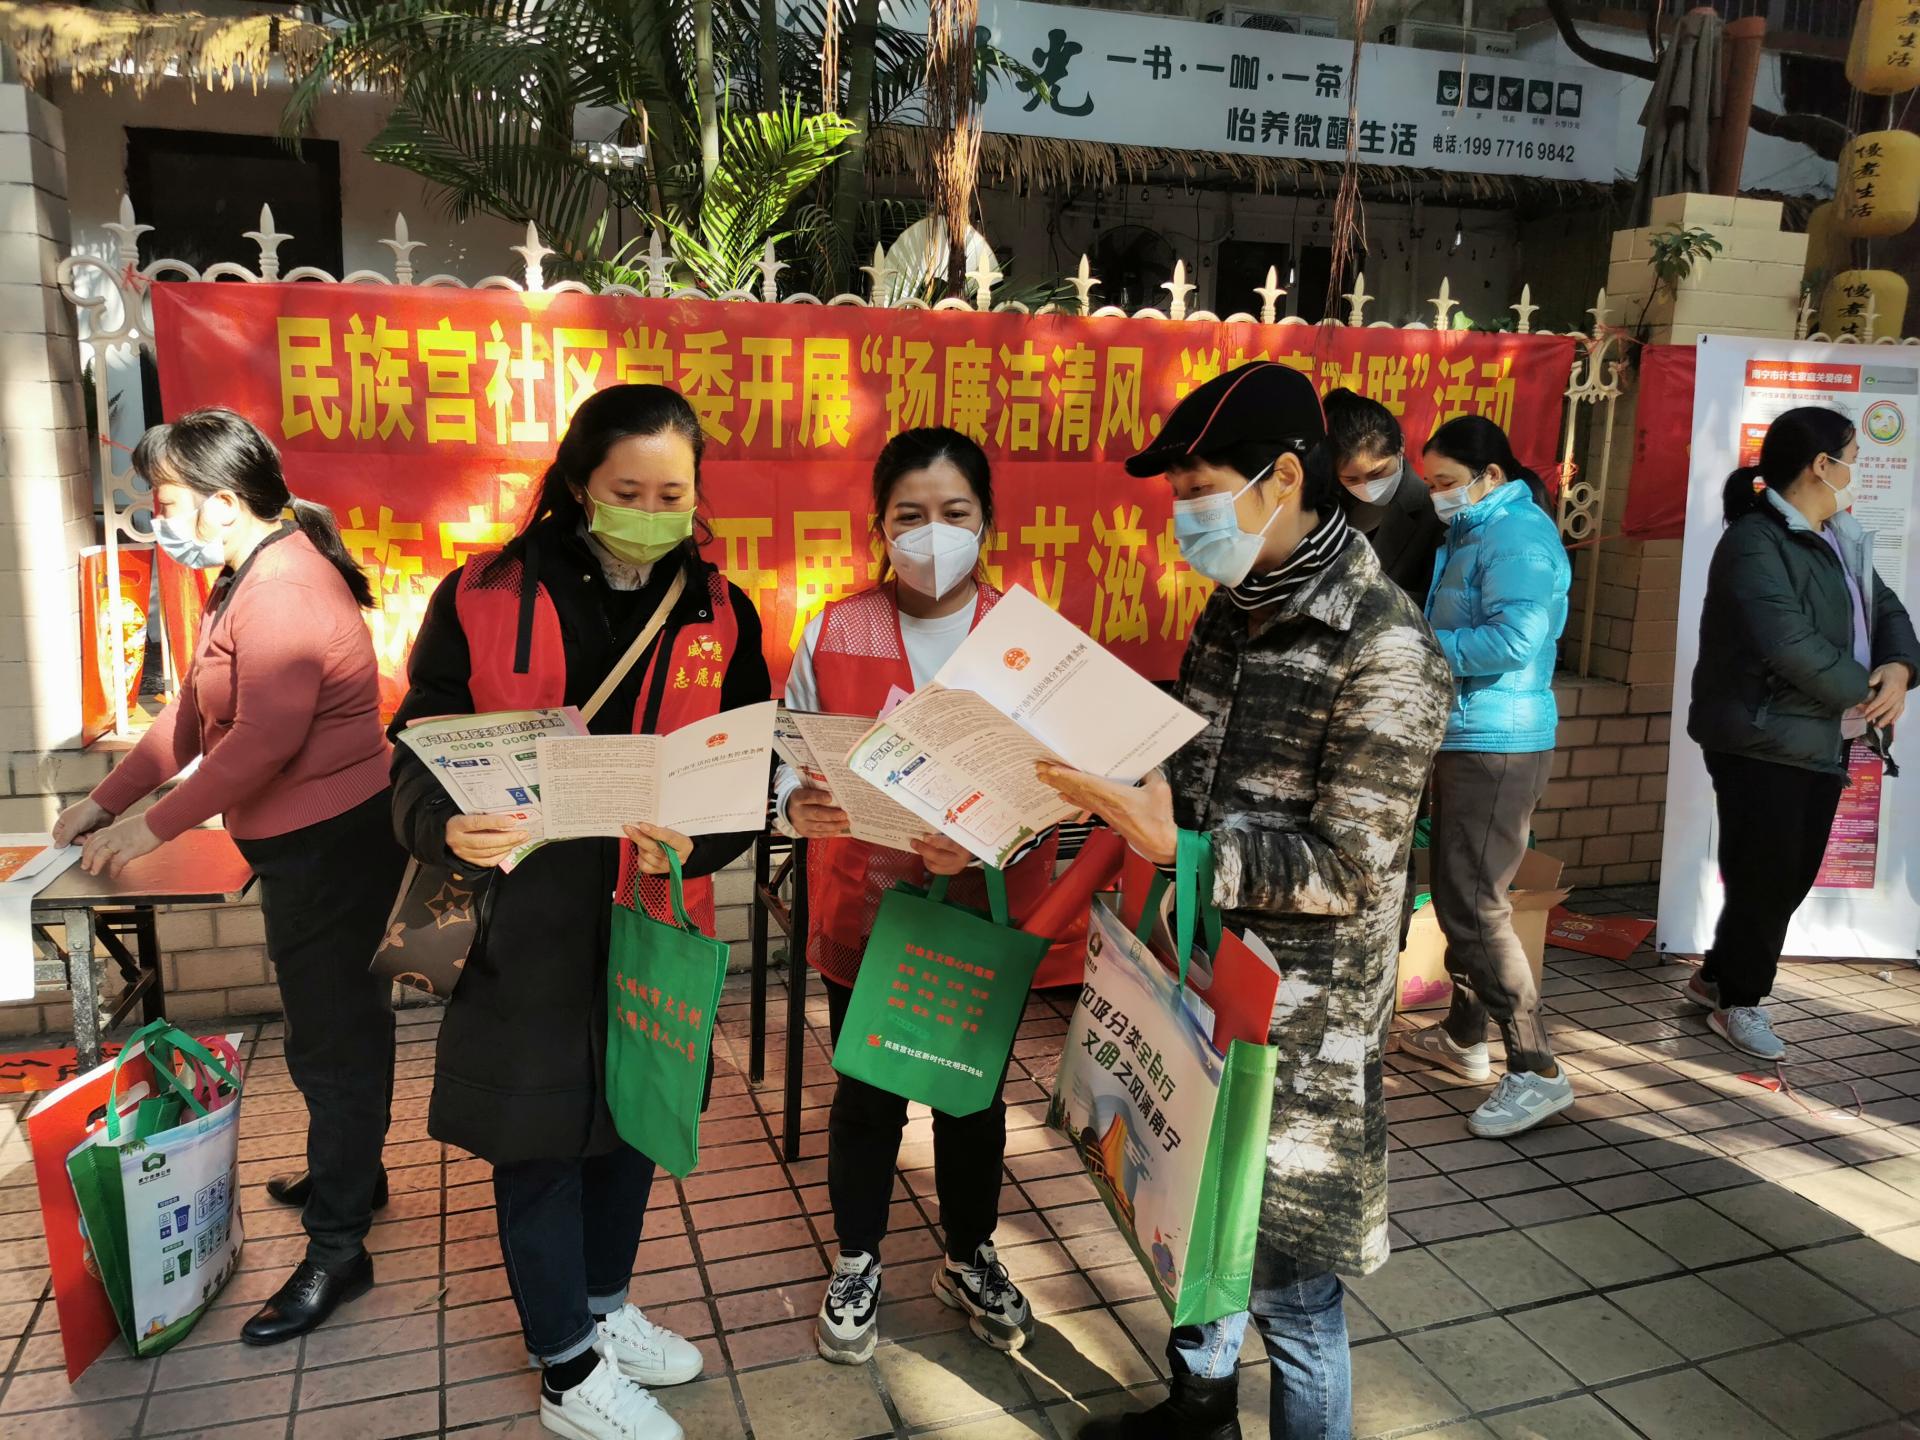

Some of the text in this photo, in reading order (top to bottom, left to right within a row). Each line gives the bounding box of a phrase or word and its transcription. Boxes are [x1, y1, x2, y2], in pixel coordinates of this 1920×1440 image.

[1081, 981, 1177, 1103] 垃圾分类全民行
[1081, 1028, 1182, 1153] 文明之风满南宁
